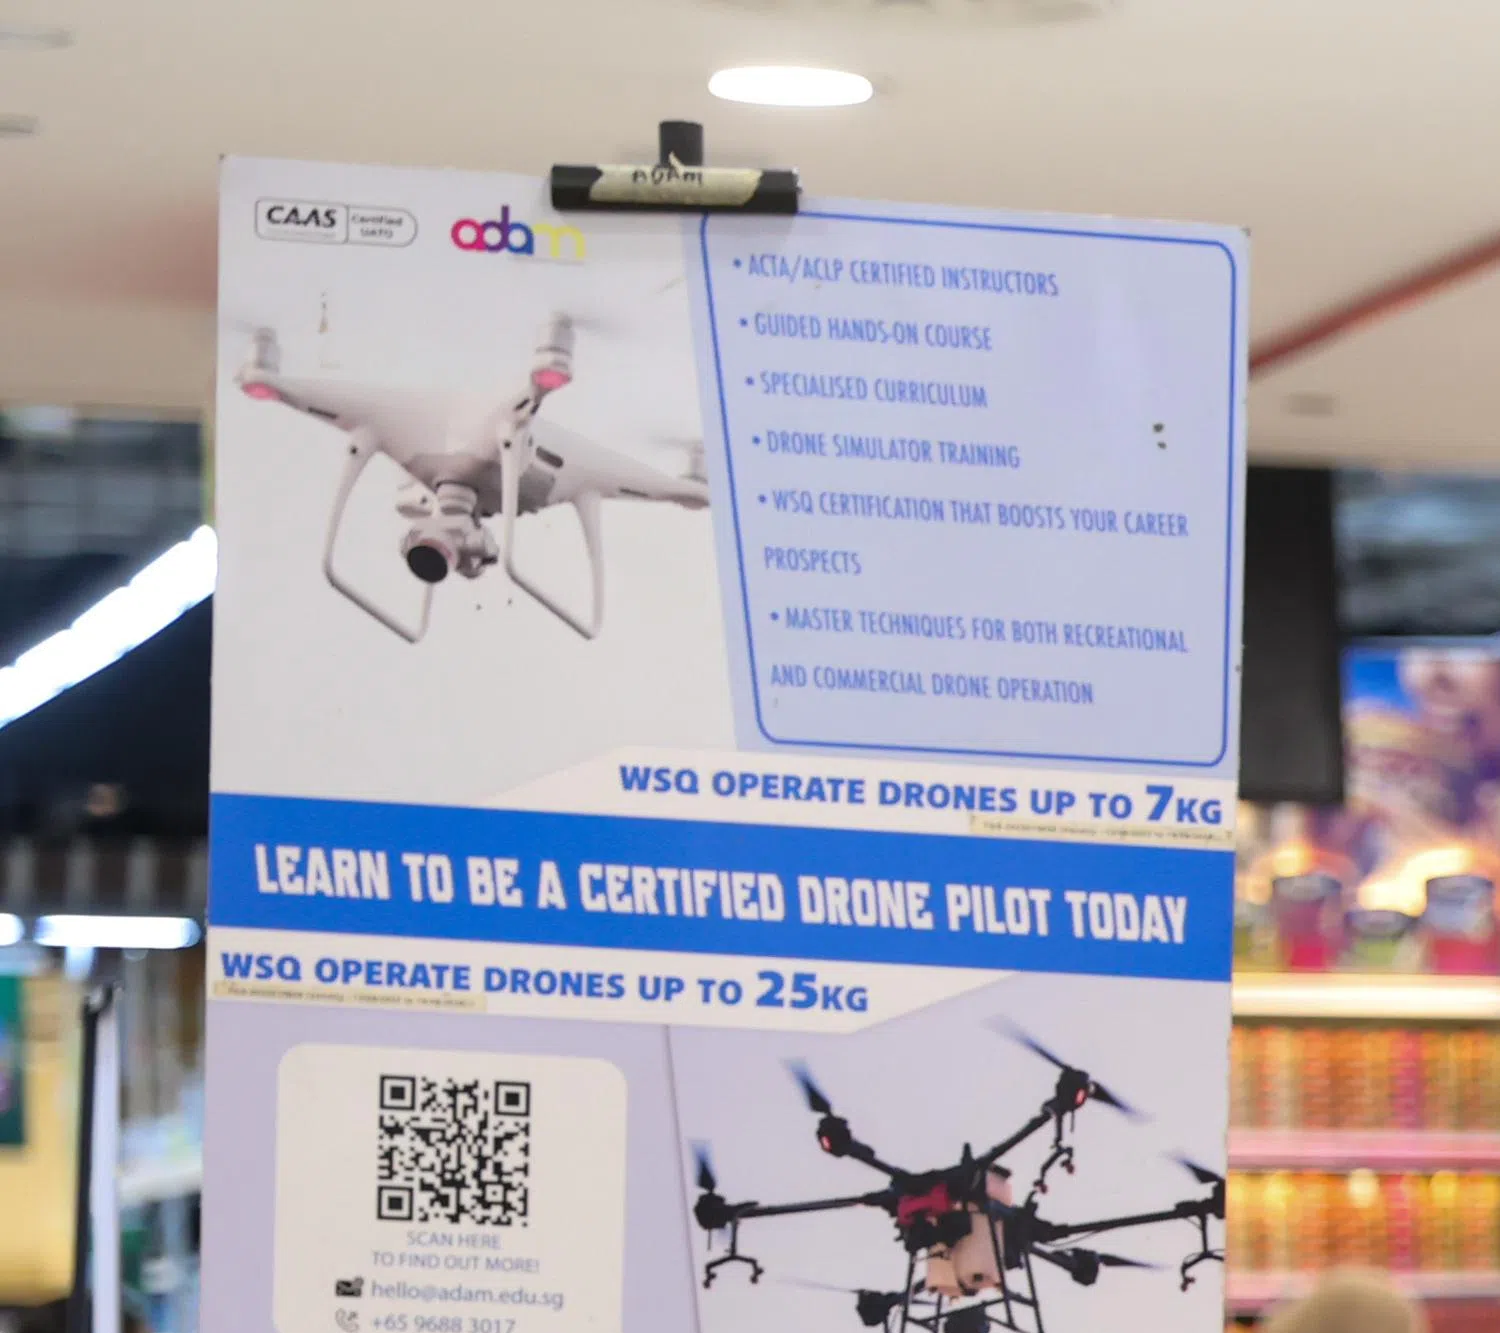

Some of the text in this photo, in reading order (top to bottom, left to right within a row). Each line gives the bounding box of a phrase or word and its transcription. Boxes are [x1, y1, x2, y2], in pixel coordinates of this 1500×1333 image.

[266, 205, 337, 229] CAAS
[451, 205, 585, 258] adam
[748, 254, 1059, 297] ACTA/ACLP CERTIFIED INSTRUCTORS
[755, 312, 992, 351] GUIDED HANDS-ON COURSE
[760, 371, 988, 407] SPECIALISED CURRICULUM
[767, 431, 1020, 469] DRONE SIMULATOR TRAINING
[772, 490, 1189, 537] WSQ CERTIFICATION THAT BOOSTS YOUR CAREER
[764, 546, 862, 575] PROSPECTS
[785, 606, 1189, 653] MASTER TECHNIQUES FOR BOTH RECREATIONAL
[771, 664, 1094, 704] AND COMMERCIAL DRONE OPERATION
[619, 765, 1223, 824] WSQ OPERATE DRONES UP TO 7KG
[255, 844, 1187, 945] LEARN TO BE A CERTIFIED DRONE PILOT TODAY
[220, 951, 301, 981] WSQ
[314, 957, 471, 991] OPERATE
[484, 967, 626, 999] DRONES
[638, 974, 685, 1002] UP
[697, 978, 743, 1005] TO
[756, 970, 868, 1013] 25KG
[407, 1231, 501, 1250] SCAN HERE
[372, 1251, 540, 1274] TO FIND OUT MORE!
[370, 1282, 564, 1310] hello@adam.edu.sg
[371, 1314, 407, 1332] +65
[414, 1315, 463, 1333] 9688
